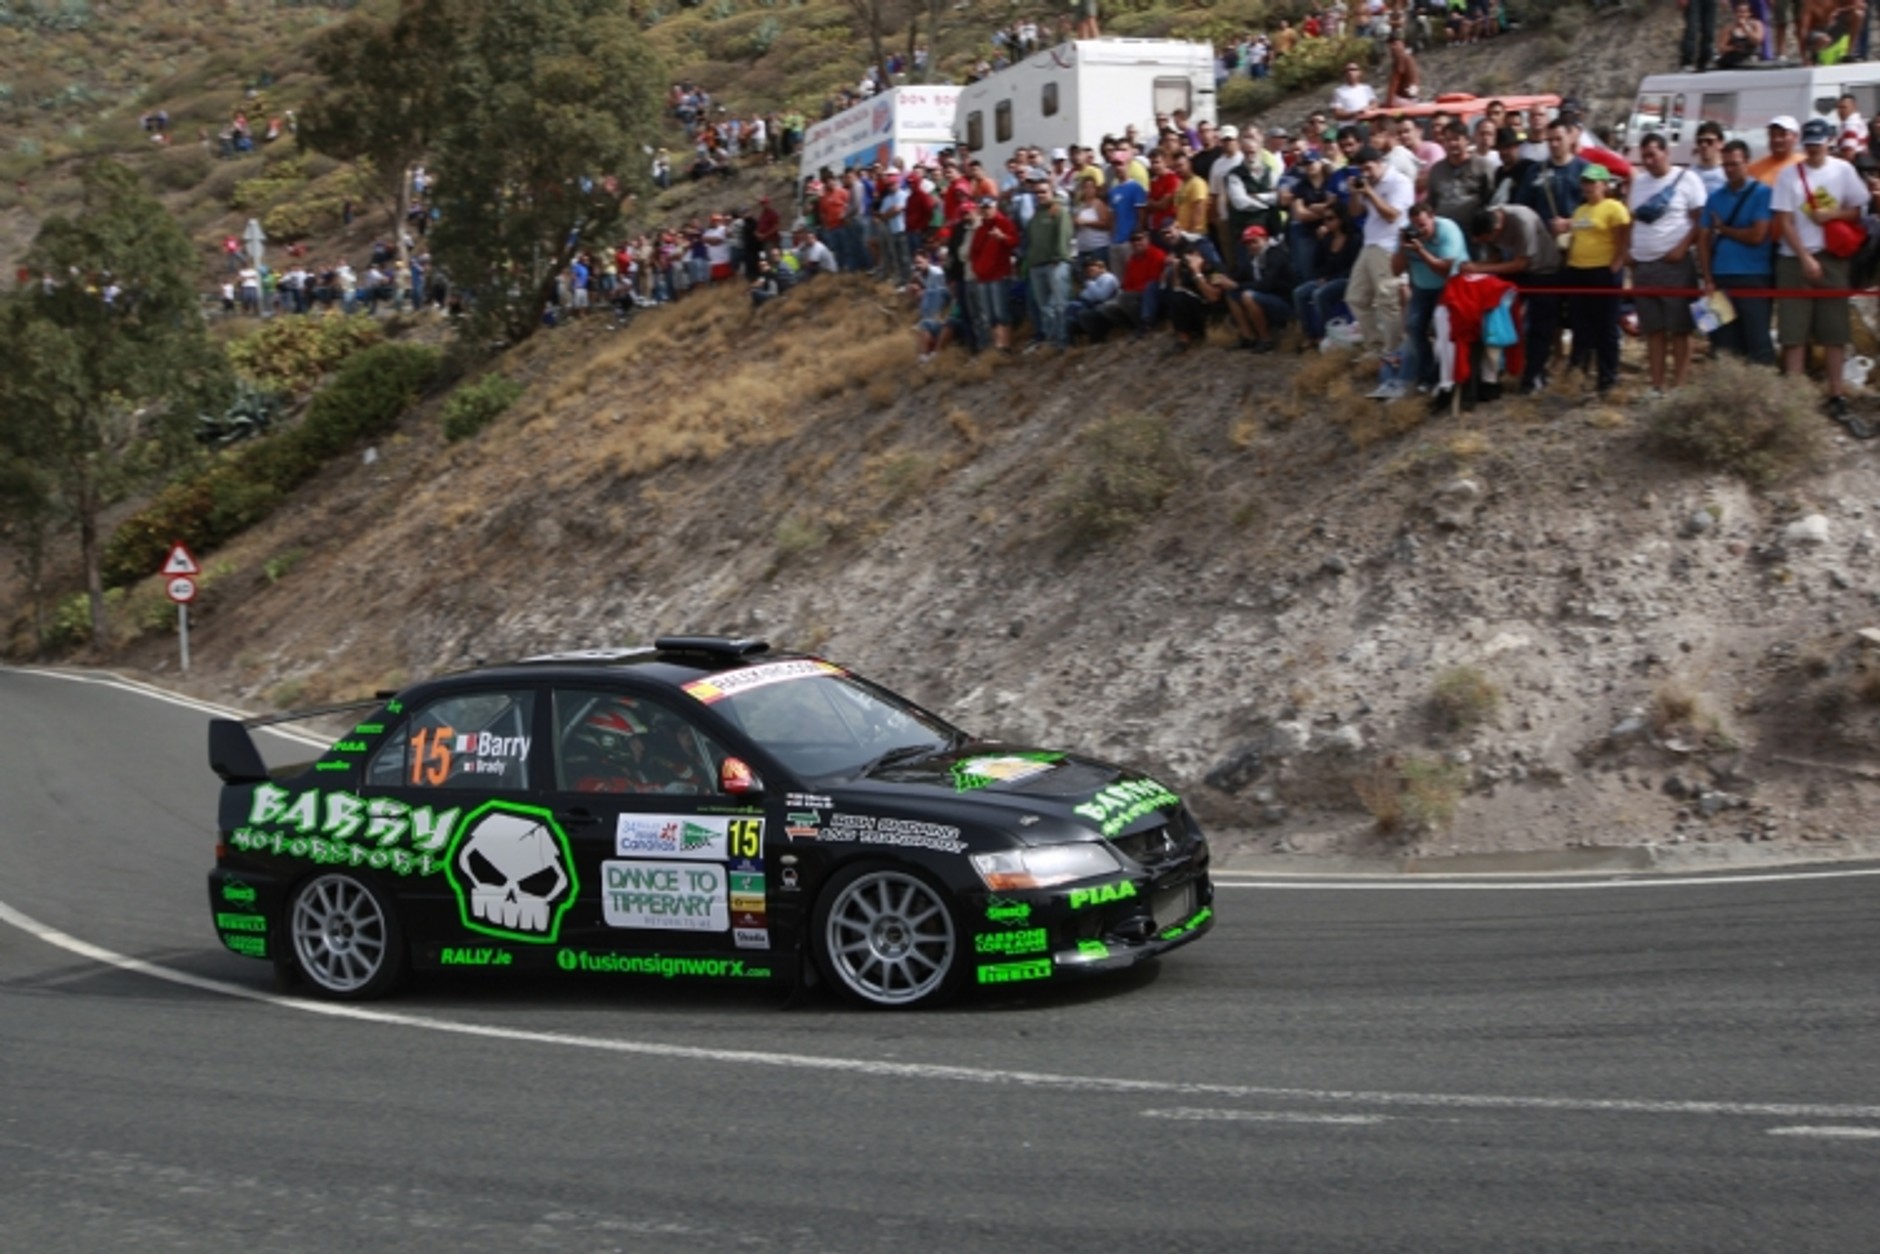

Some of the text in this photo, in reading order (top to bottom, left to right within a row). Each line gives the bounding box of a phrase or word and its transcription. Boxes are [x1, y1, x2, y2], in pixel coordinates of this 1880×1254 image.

[411, 726, 454, 785] 15
[477, 731, 531, 762] Barry
[476, 760, 506, 775] Brady
[248, 781, 462, 850] BARRY
[621, 837, 676, 851] Canarias
[729, 819, 760, 857] 15
[607, 867, 719, 893] DANCE TO
[1069, 879, 1137, 910] PIAA
[608, 890, 716, 917] TIPPERARY
